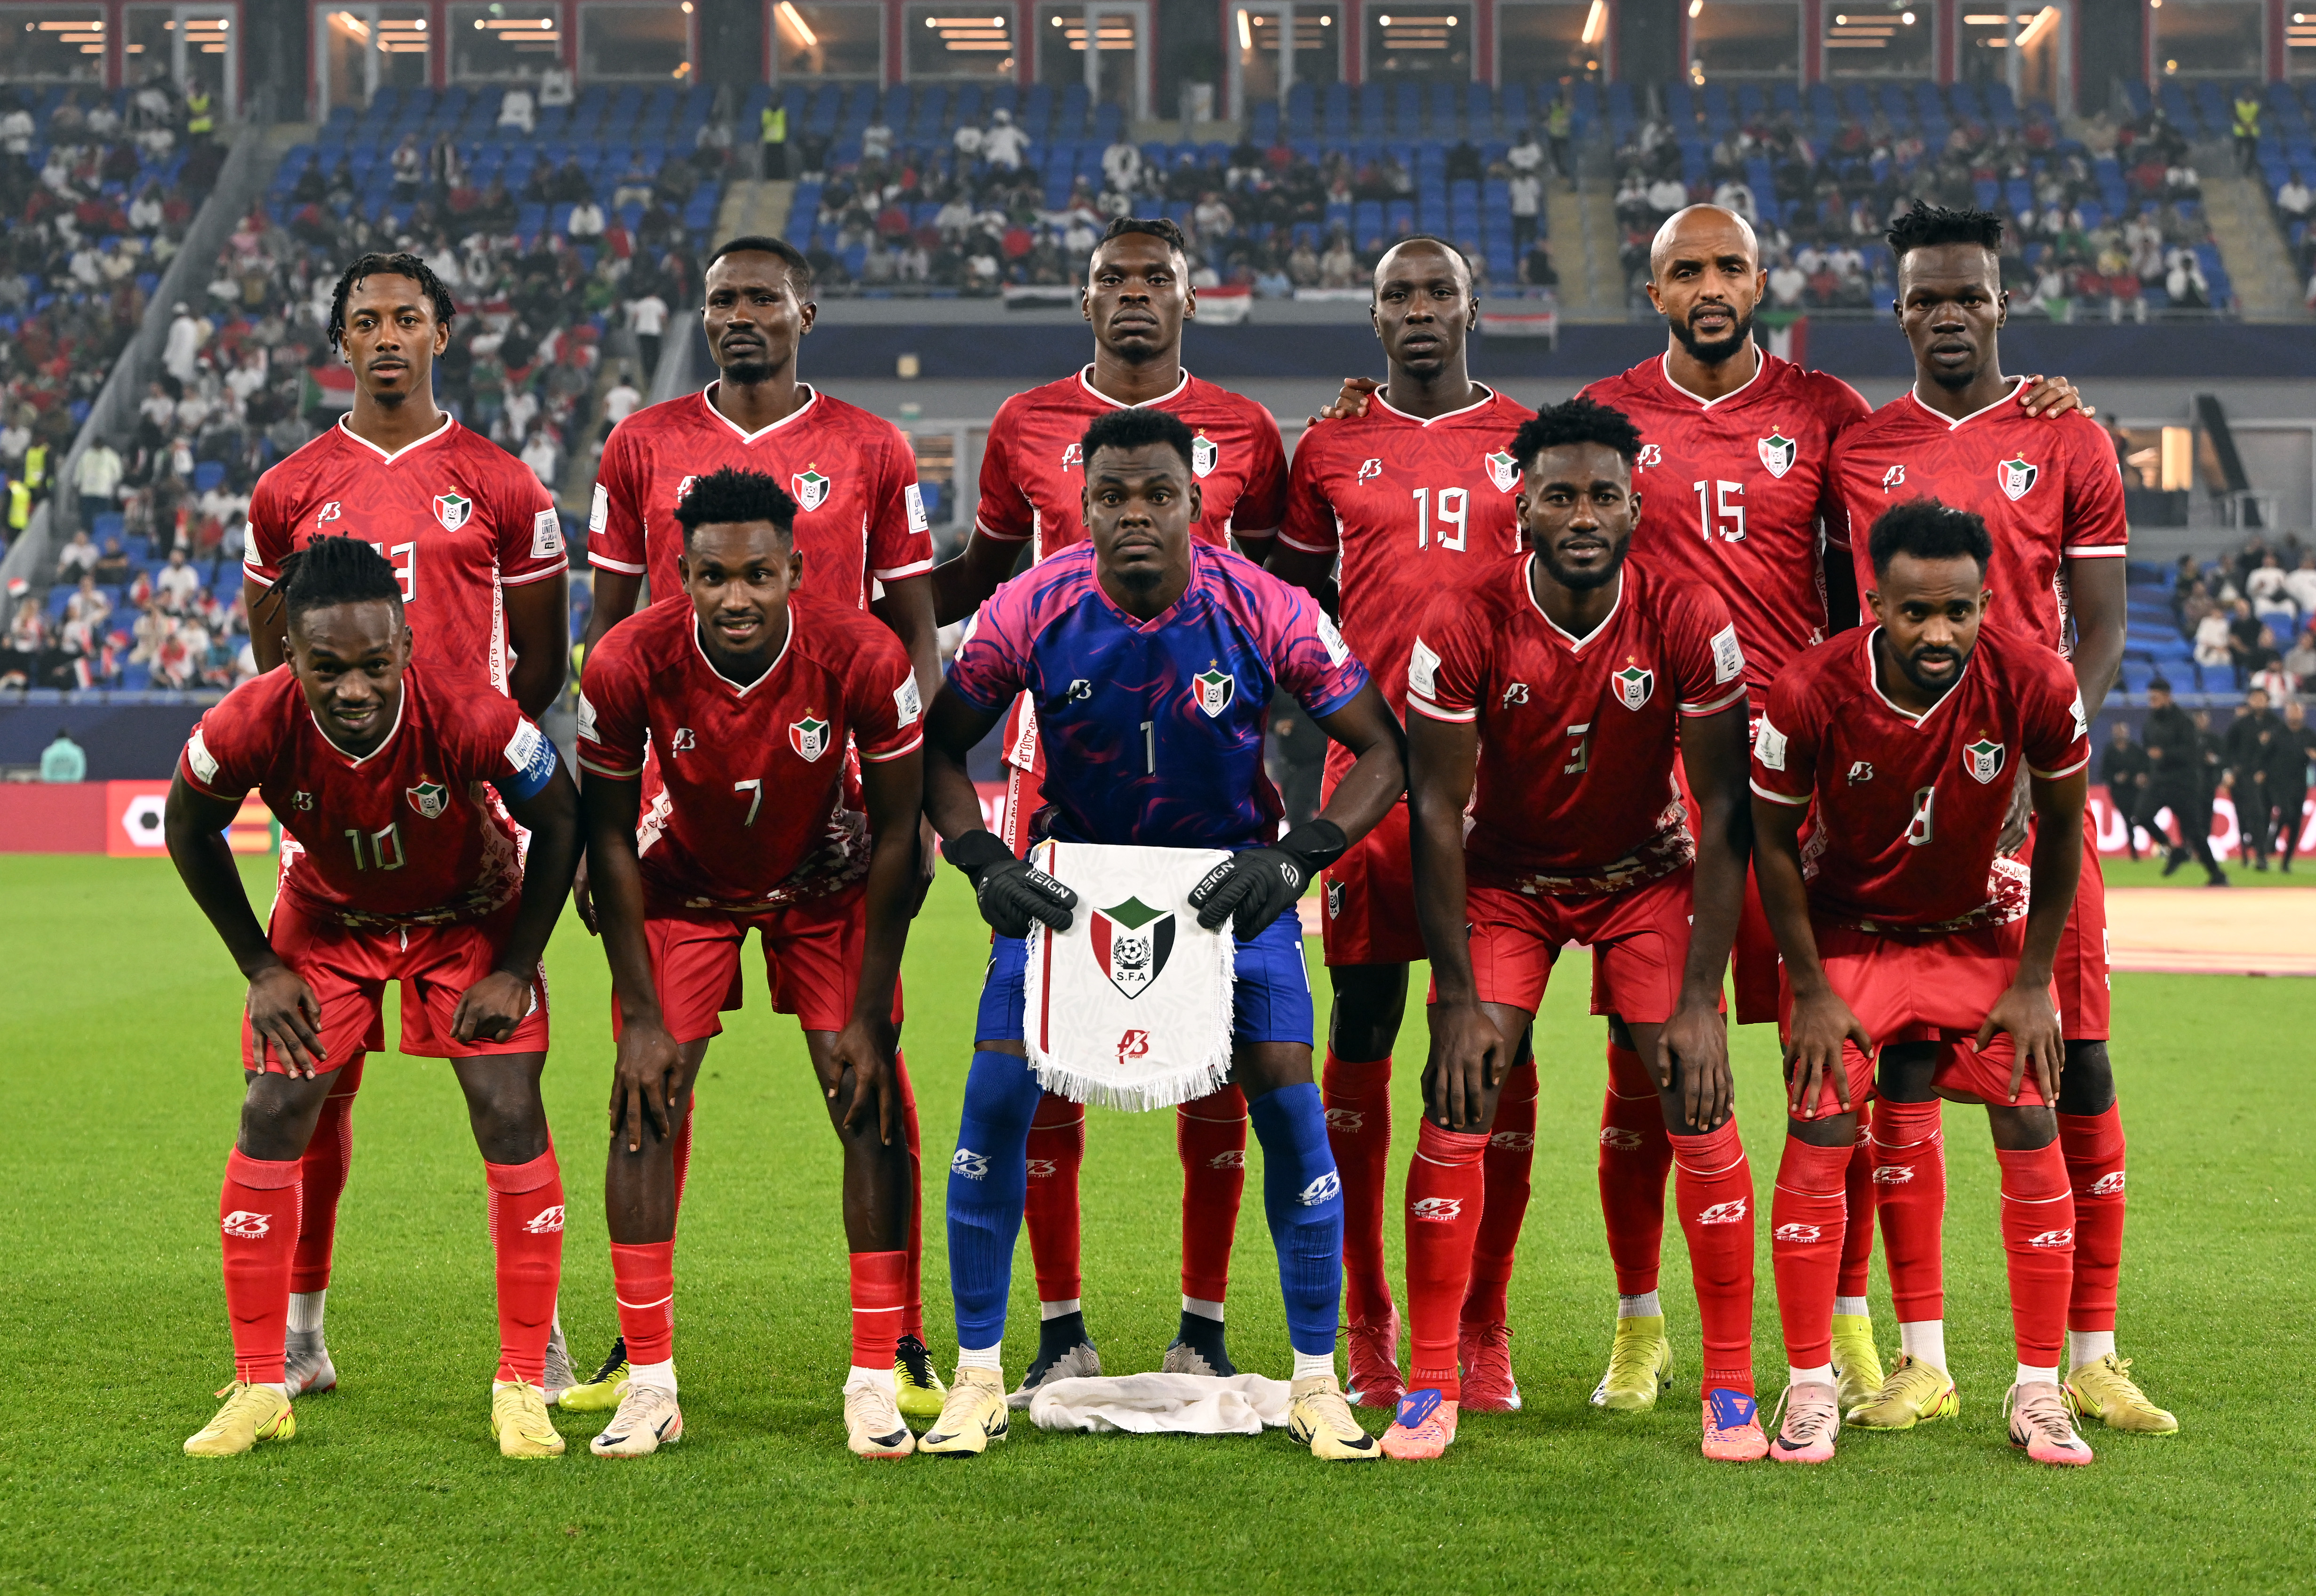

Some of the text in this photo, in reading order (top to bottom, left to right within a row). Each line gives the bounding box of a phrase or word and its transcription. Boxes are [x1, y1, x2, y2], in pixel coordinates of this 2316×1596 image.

[1413, 487, 1469, 552] 19
[1694, 479, 1745, 543] 15
[370, 541, 416, 604] 3
[518, 733, 532, 757] UNITES
[526, 741, 543, 773] UNIT
[1140, 721, 1155, 777] 1
[1565, 722, 1590, 774] 3
[735, 779, 763, 827] 7
[345, 822, 407, 871] 10
[1027, 867, 1070, 899] REIGN
[1193, 860, 1235, 901] REIGN
[1116, 970, 1146, 982] S.F.A
[1115, 1029, 1150, 1064] AB
[229, 1229, 267, 1239] SPORT
[538, 1223, 565, 1233] SPORT
[1420, 1211, 1458, 1221] SPORT
